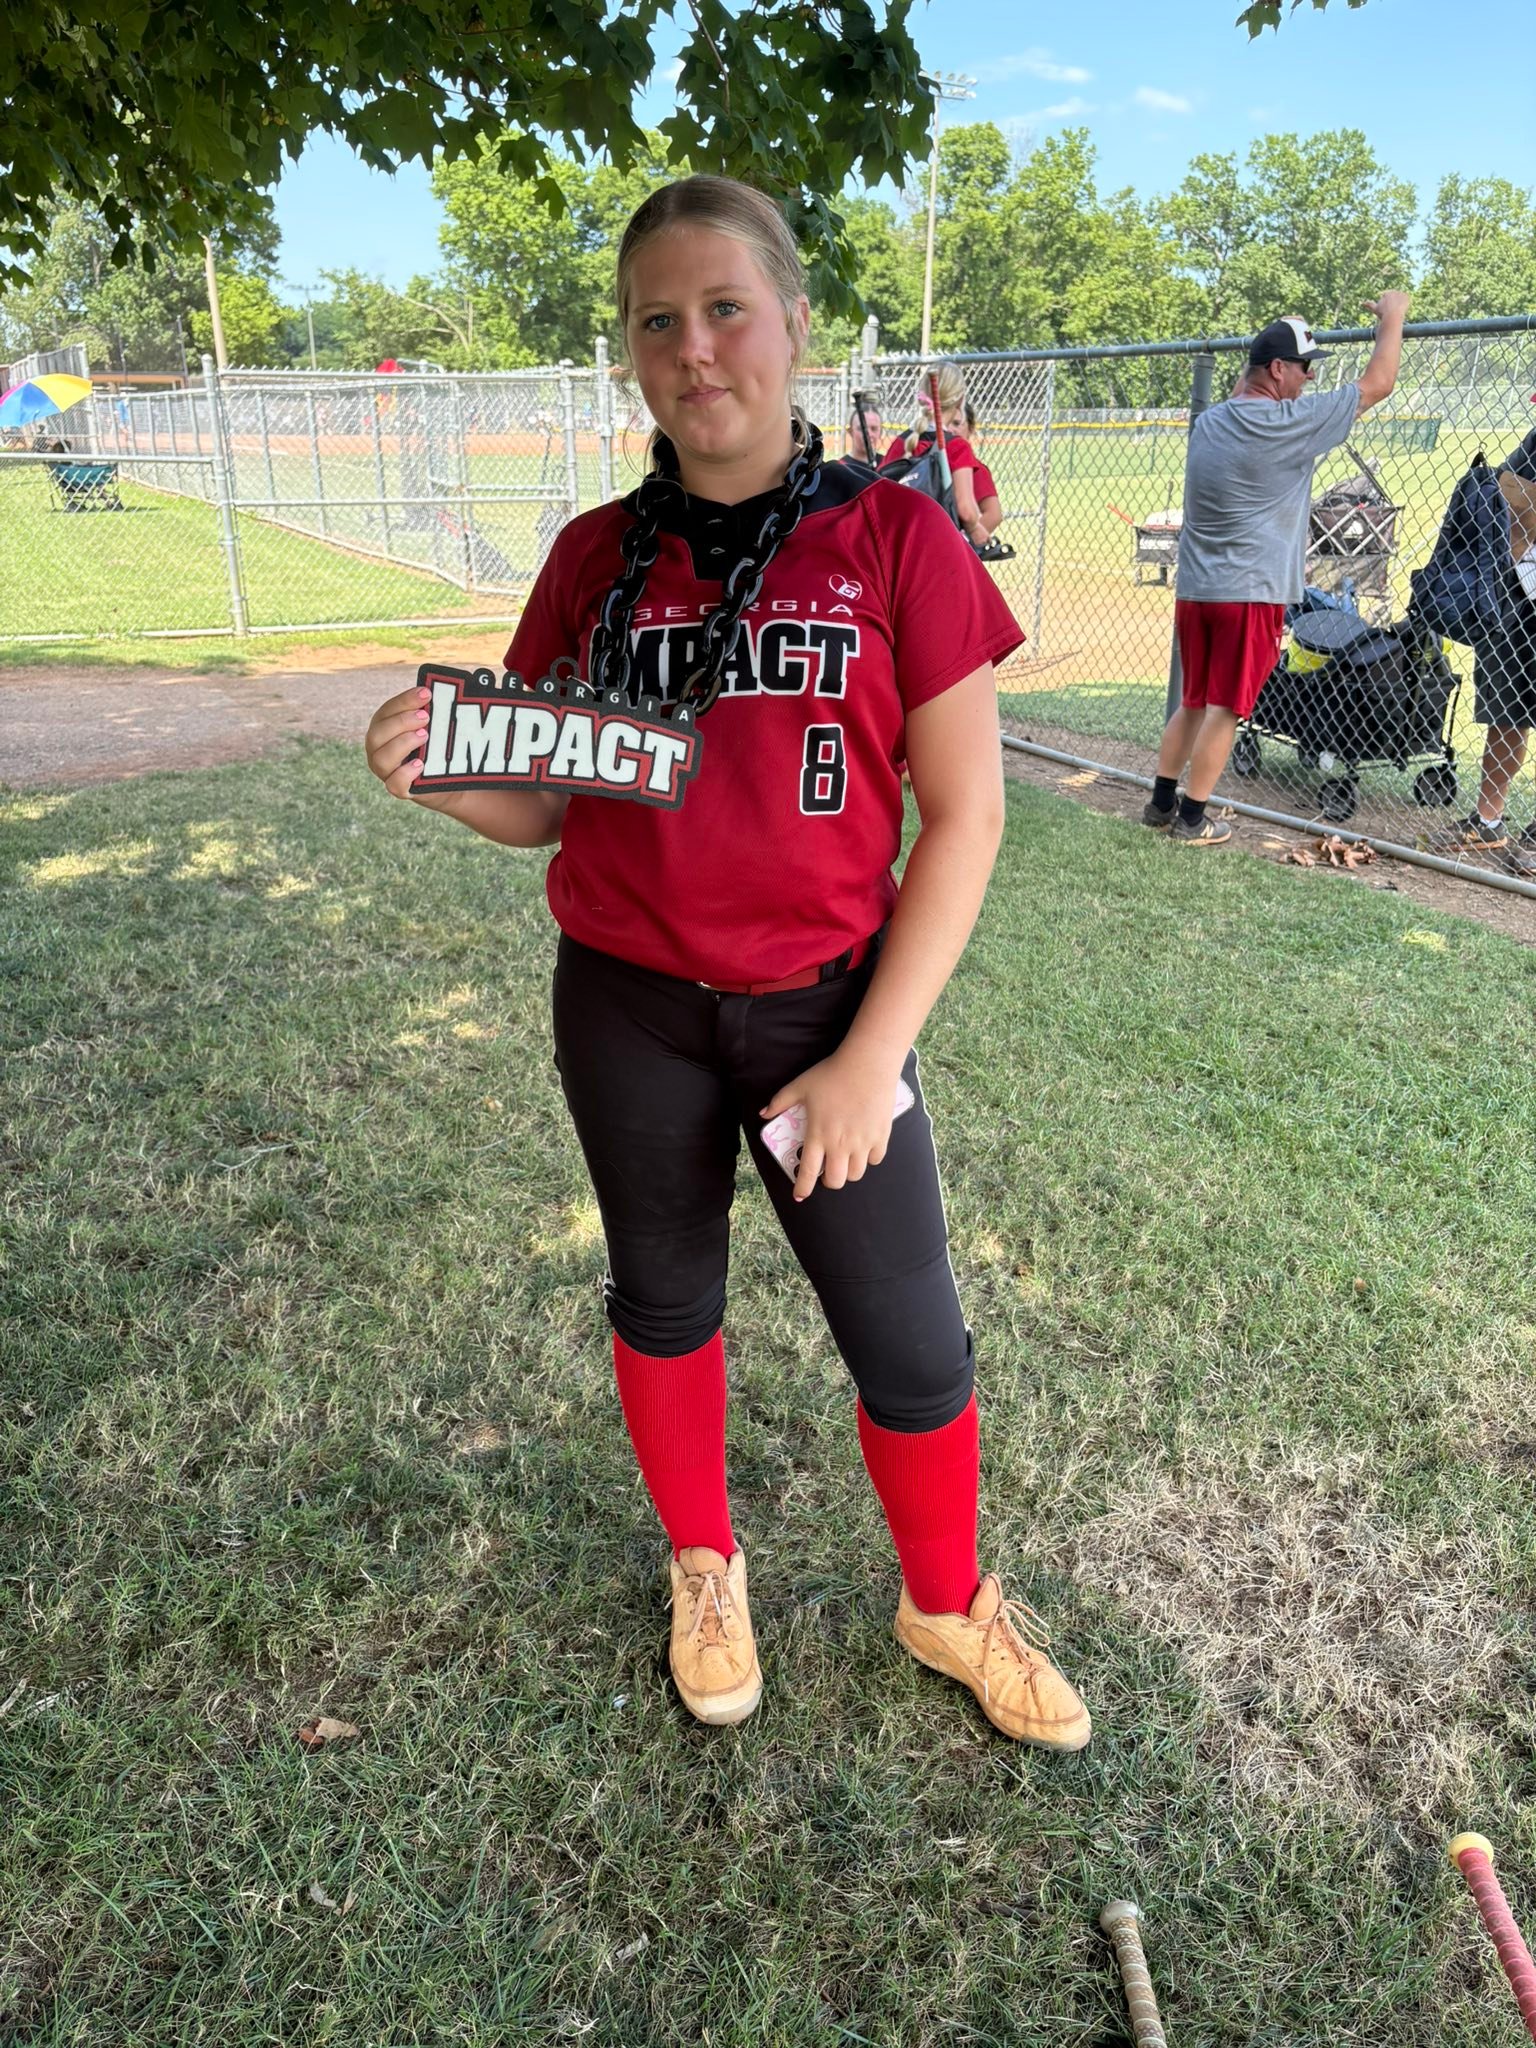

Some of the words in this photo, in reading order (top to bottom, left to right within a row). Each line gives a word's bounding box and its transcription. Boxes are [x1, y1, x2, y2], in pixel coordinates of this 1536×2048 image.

[423, 681, 688, 793] IMPACT
[478, 674, 689, 722] GEORGIA
[799, 723, 848, 815] 8
